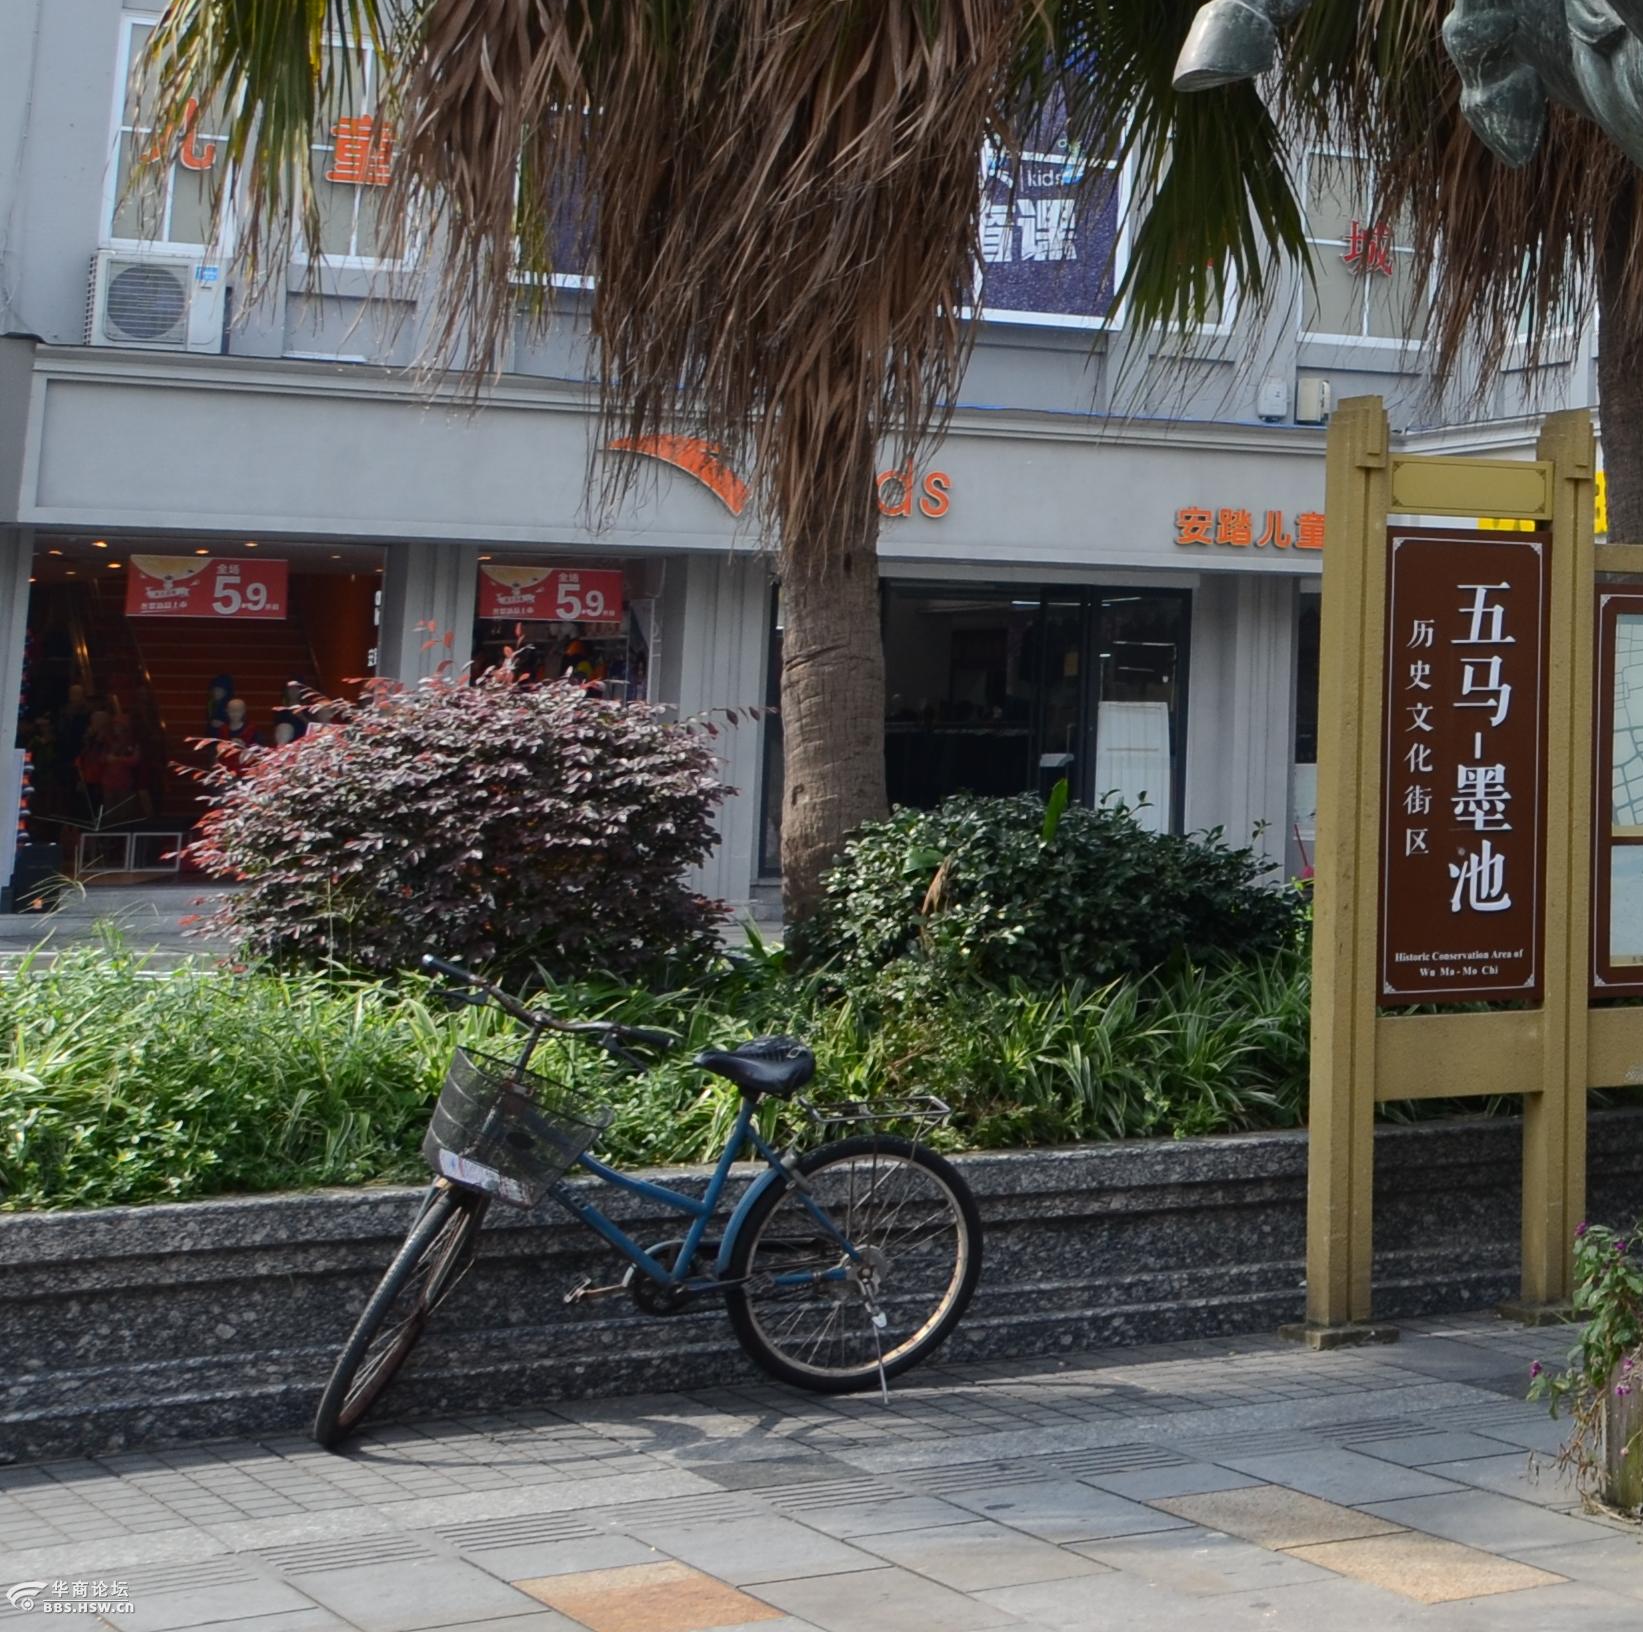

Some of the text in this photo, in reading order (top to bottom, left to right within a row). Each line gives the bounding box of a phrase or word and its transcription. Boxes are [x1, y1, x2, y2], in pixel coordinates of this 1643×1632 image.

[1174, 506, 1325, 550] 安踏儿童
[1402, 619, 1435, 857] 历史文化街区
[1395, 948, 1524, 962] Historic Conservation Area of
[1481, 965, 1498, 975] Chi
